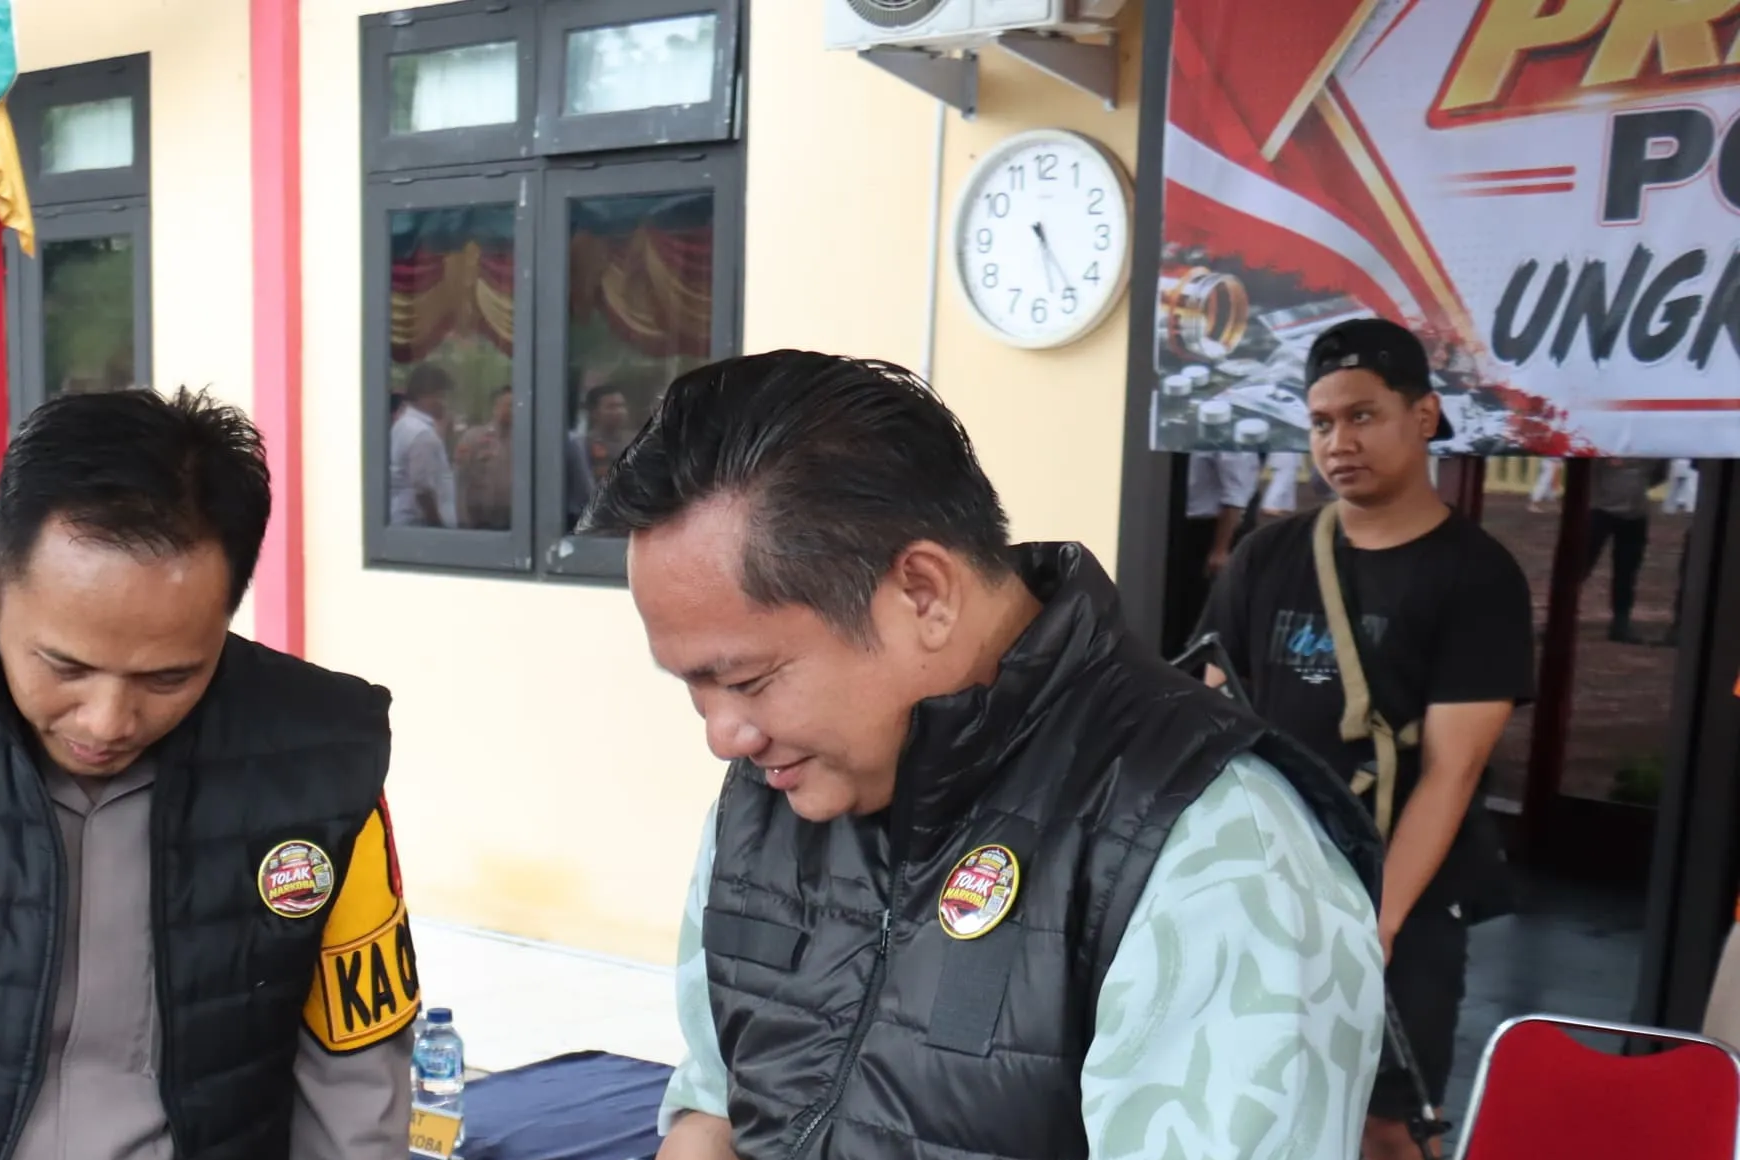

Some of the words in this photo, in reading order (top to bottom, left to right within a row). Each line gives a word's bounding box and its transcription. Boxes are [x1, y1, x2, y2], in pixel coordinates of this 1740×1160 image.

[1437, 0, 1740, 112] PR
[1008, 165, 1025, 191] 11
[1034, 154, 1059, 181] 12
[1071, 161, 1080, 189] 1
[1601, 106, 1740, 224] P
[985, 192, 1011, 219] 10
[1087, 188, 1105, 215] 2
[976, 227, 993, 254] 9
[1093, 223, 1110, 251] 3
[981, 262, 999, 289] 8
[1082, 261, 1101, 287] 4
[1008, 287, 1023, 315] 7
[1031, 298, 1048, 324] 6
[1061, 286, 1078, 315] 5
[270, 865, 312, 888] TOLAK
[952, 870, 993, 897] TOLAK
[336, 941, 396, 1033] KA
